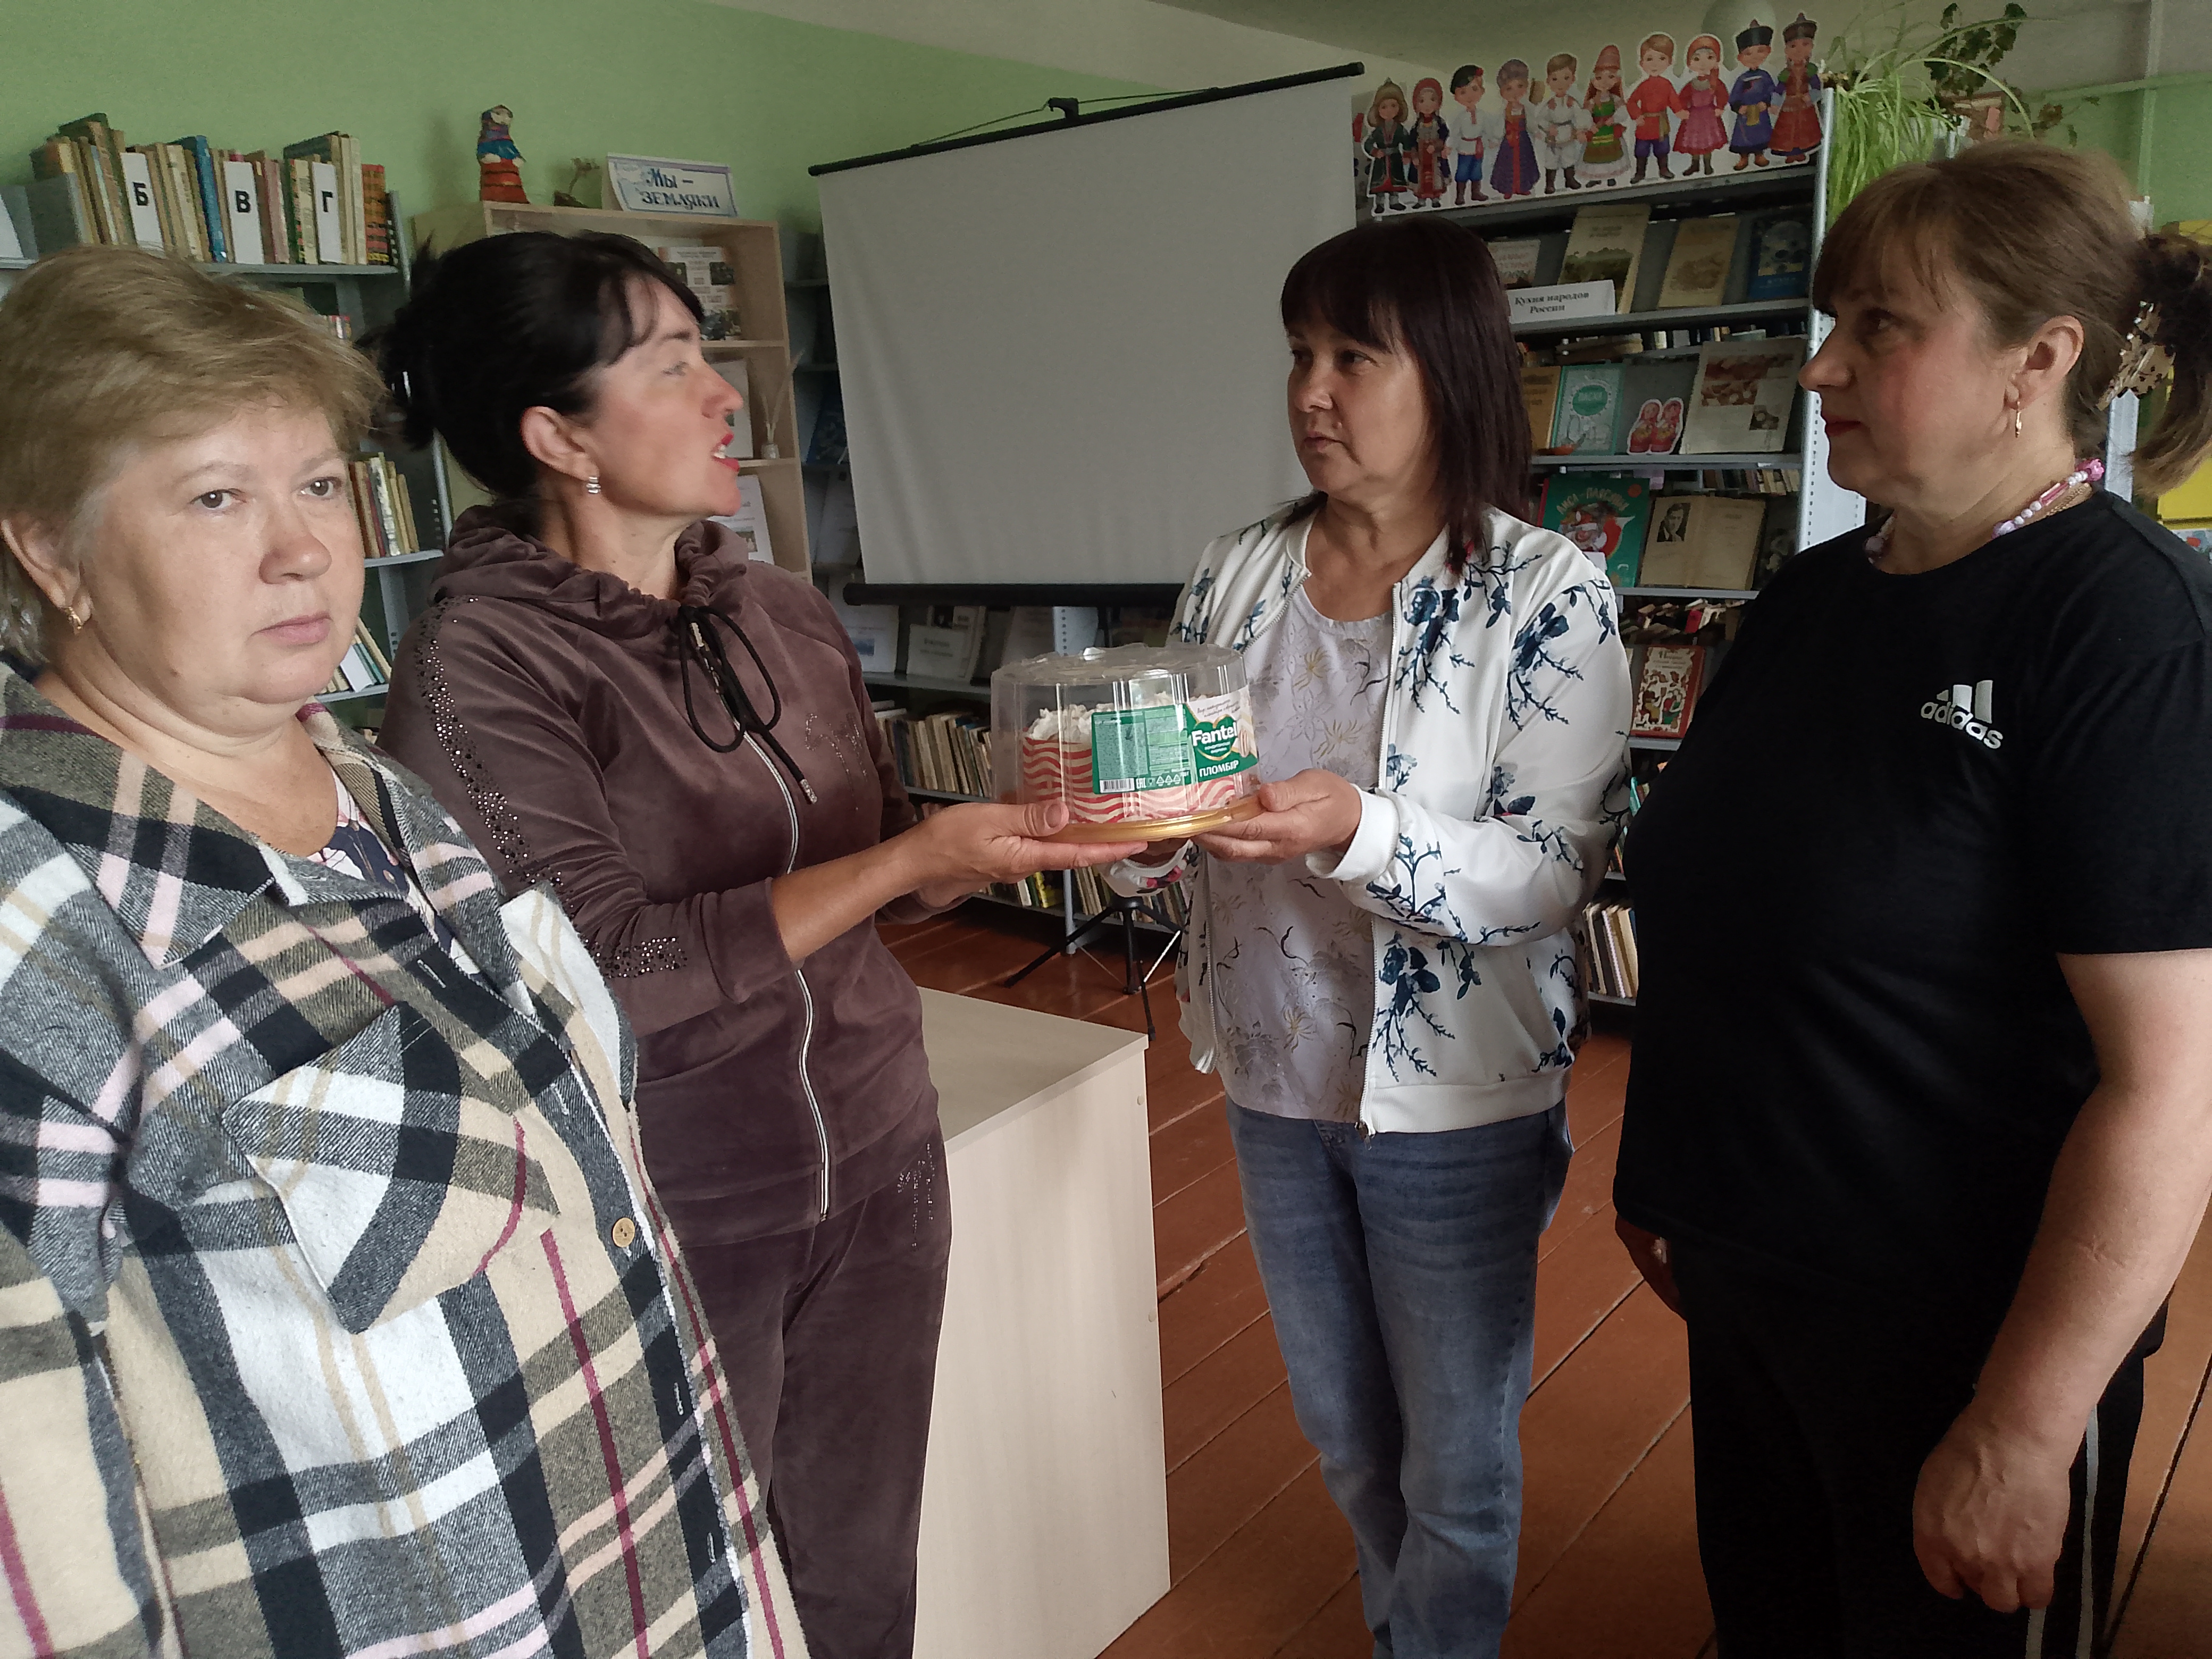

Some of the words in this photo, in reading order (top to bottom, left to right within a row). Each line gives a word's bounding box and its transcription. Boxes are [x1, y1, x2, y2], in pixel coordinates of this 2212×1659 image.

[645, 168, 678, 188] Мы
[132, 181, 149, 206] Б
[234, 190, 251, 213] В
[321, 190, 333, 213] Г
[1515, 296, 1545, 307] Кухня
[1547, 292, 1589, 303] народов
[1529, 305, 1565, 314] России
[1191, 722, 1238, 747] Fantel
[1920, 701, 2004, 749] adidas
